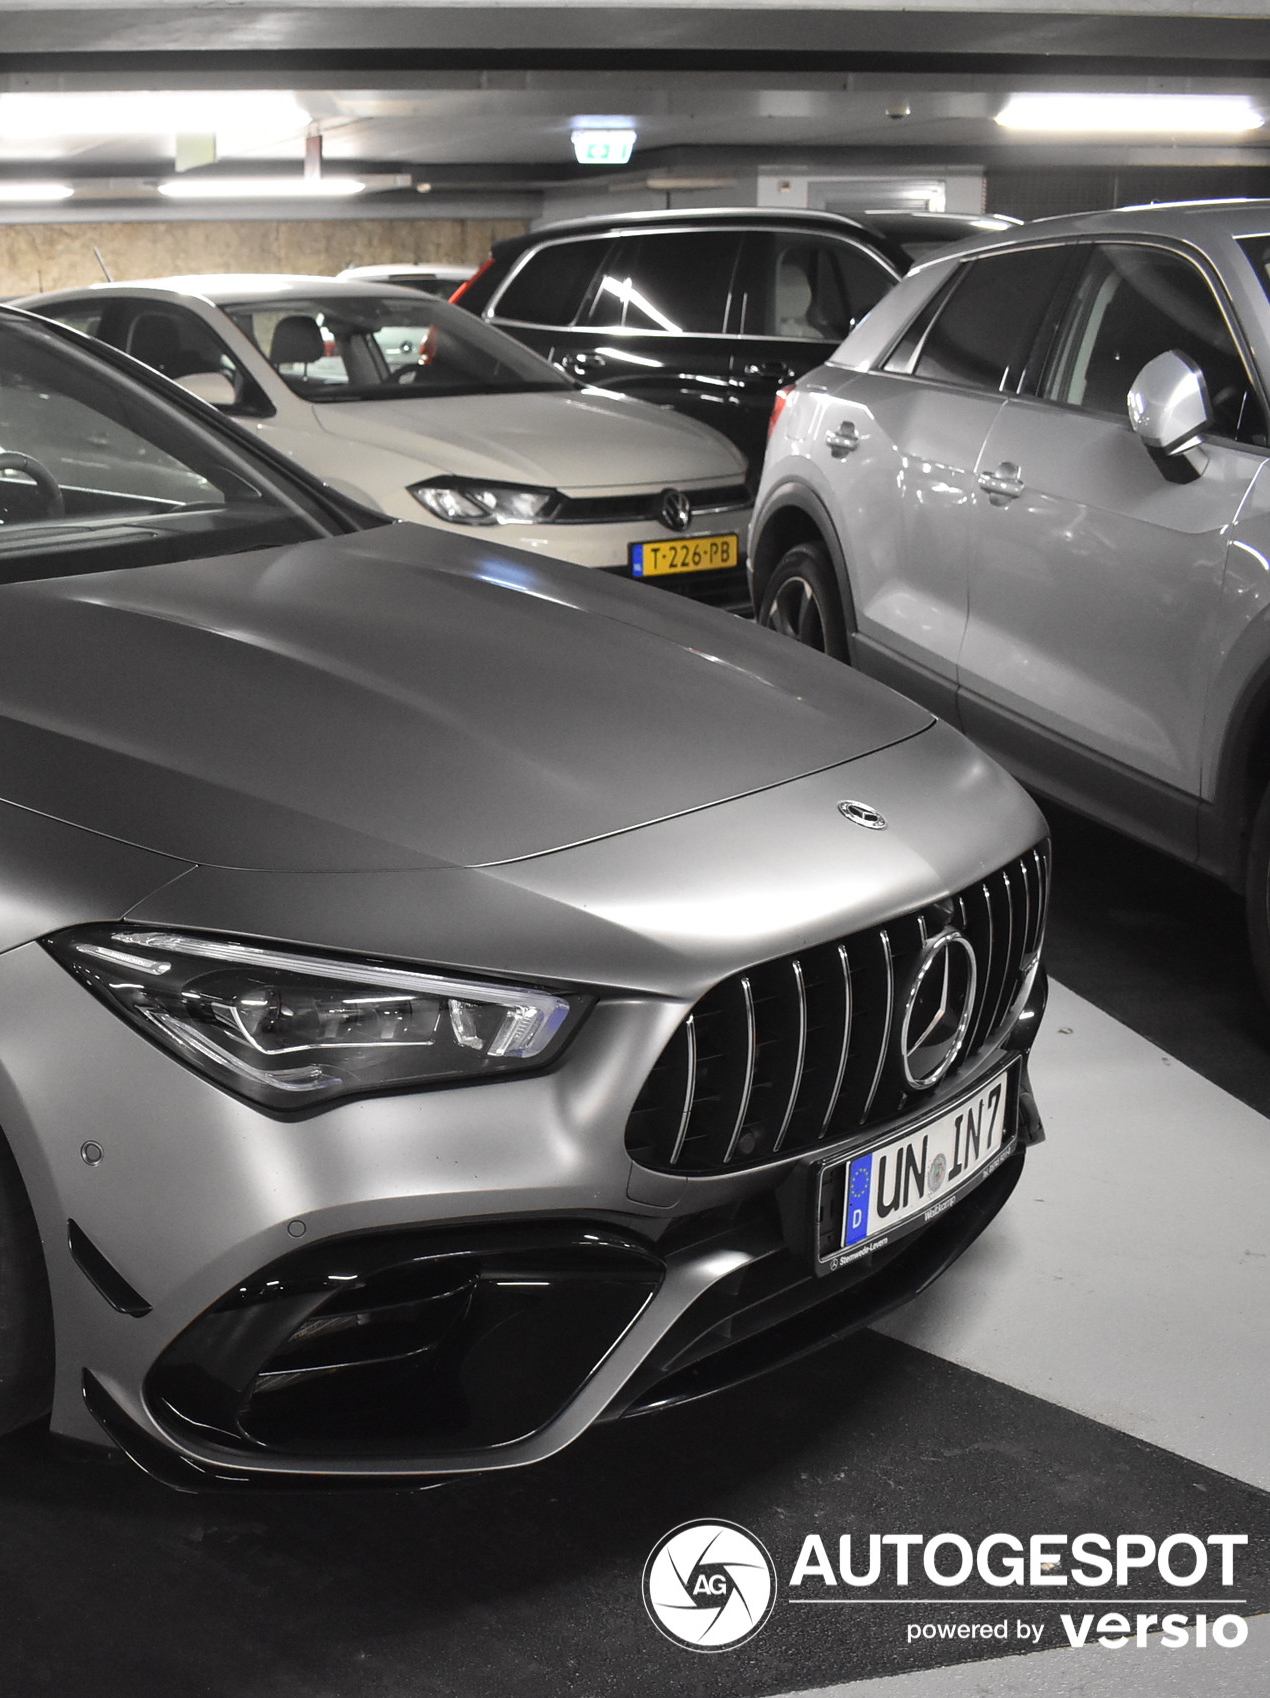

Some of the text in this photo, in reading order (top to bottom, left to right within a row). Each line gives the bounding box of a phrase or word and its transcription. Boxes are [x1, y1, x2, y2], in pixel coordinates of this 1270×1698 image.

[650, 541, 730, 569] T-226-PB
[852, 1209, 862, 1229] D
[876, 1134, 929, 1219] UN
